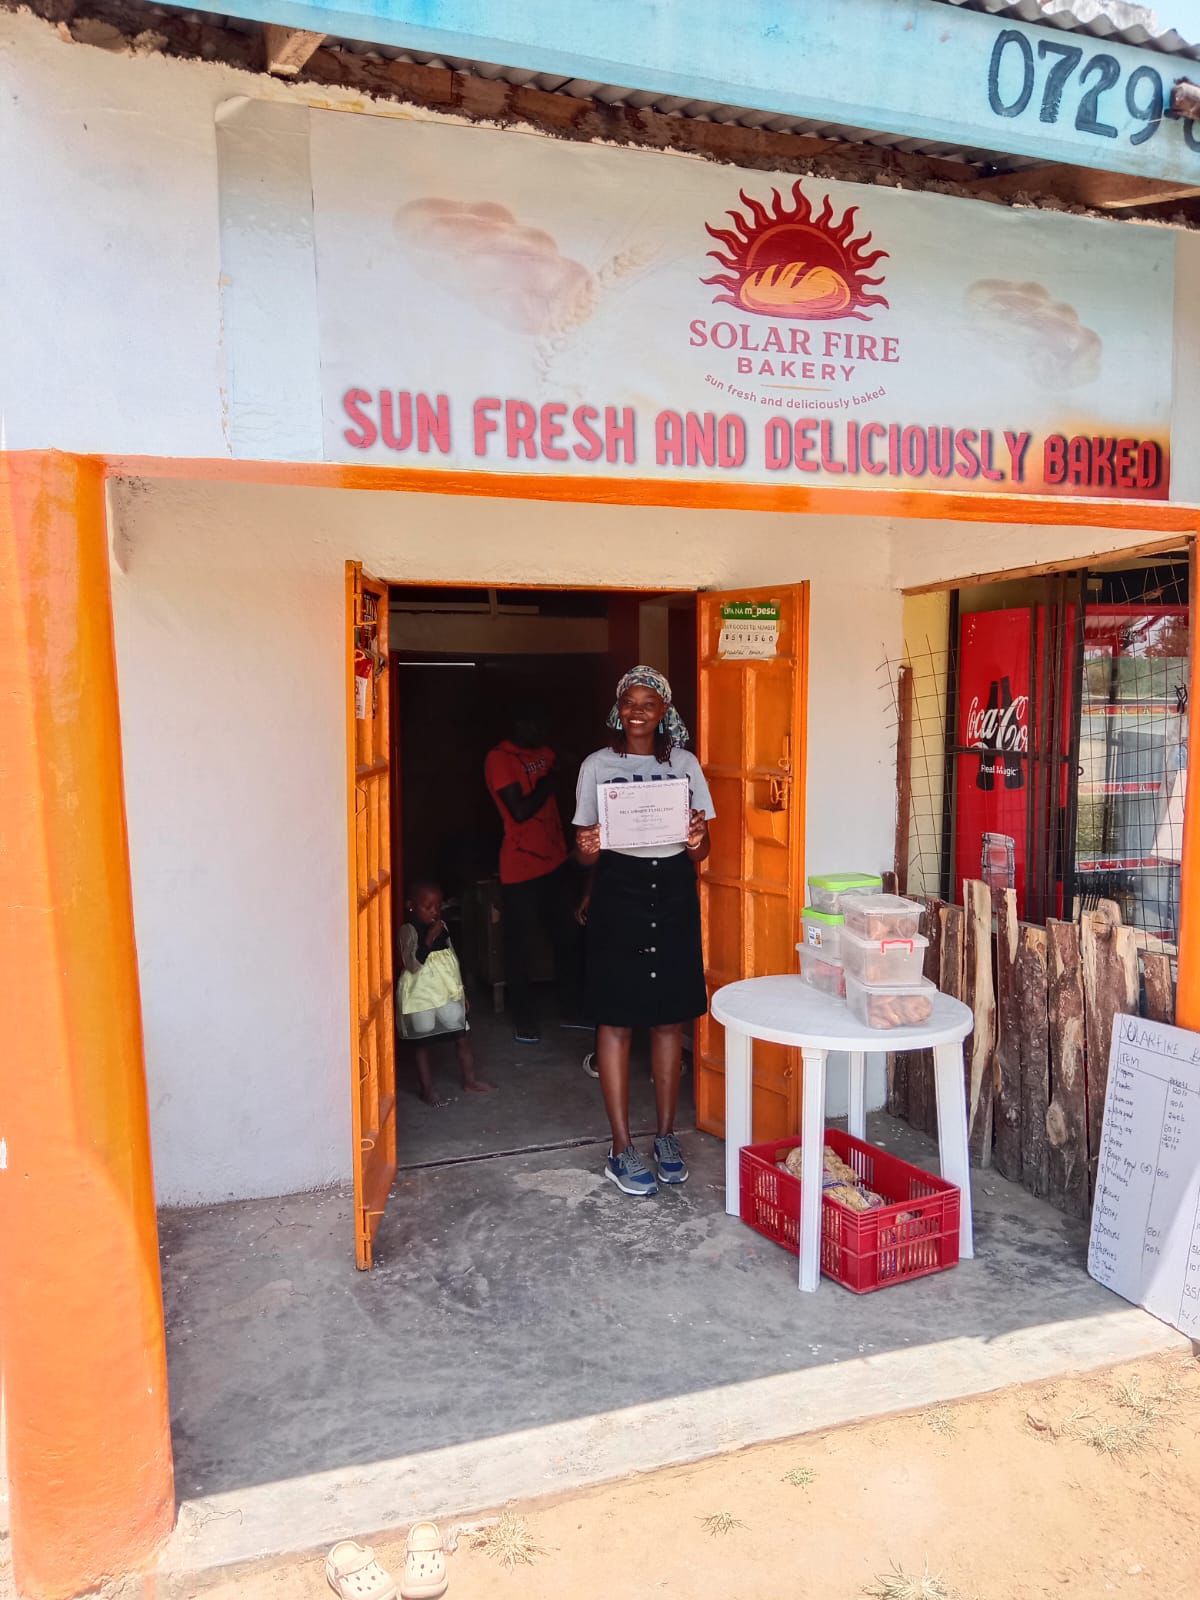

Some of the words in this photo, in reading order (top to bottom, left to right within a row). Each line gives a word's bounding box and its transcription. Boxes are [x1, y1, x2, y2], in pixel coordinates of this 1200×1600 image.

[988, 29, 1164, 145] 0729
[689, 319, 812, 356] SOLAR
[822, 331, 900, 363] FIRE
[737, 357, 855, 382] BAKERY
[704, 373, 724, 390] sun
[727, 384, 757, 402] fresh
[760, 397, 783, 408] and
[786, 398, 850, 410] deliciously
[853, 385, 887, 406] baked
[343, 387, 451, 454] SUN
[472, 397, 636, 465] FRESH
[655, 410, 747, 469] AND
[764, 416, 1031, 483] DELICIOUSLY
[1043, 434, 1162, 489] BAKED
[981, 764, 995, 774] Real
[996, 765, 1017, 777] Magic
